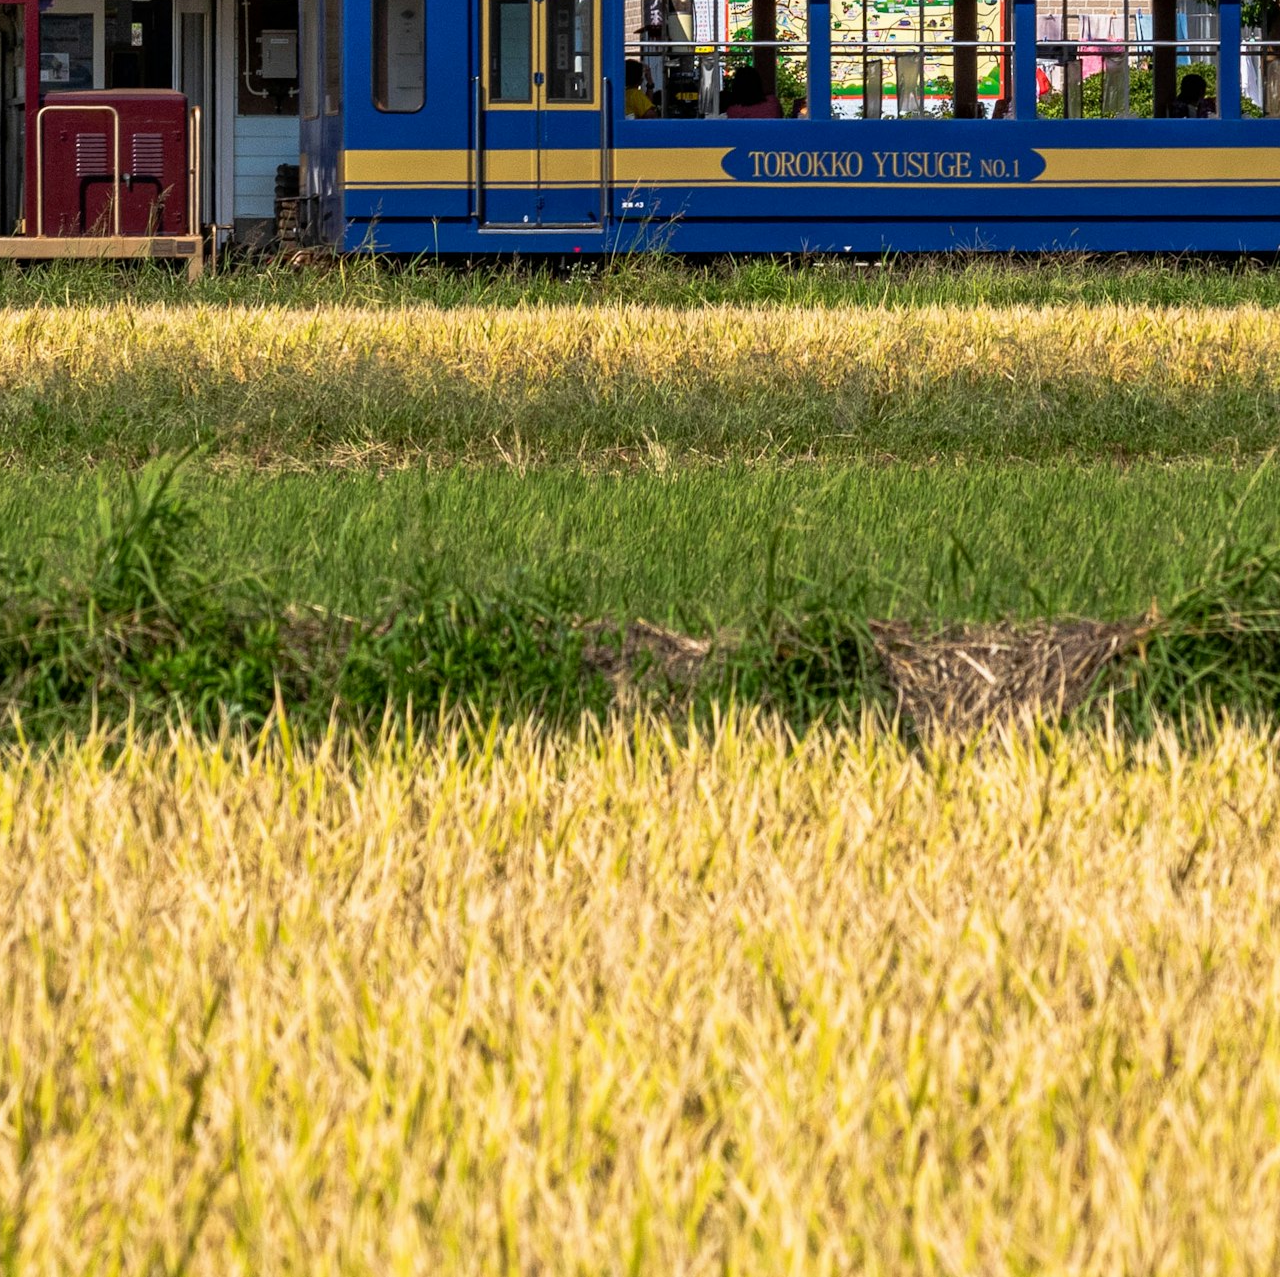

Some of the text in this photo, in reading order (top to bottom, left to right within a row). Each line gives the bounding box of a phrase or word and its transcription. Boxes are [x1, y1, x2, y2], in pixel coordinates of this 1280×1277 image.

[748, 151, 1020, 178] TOROKKO YUSUGE NO.1
